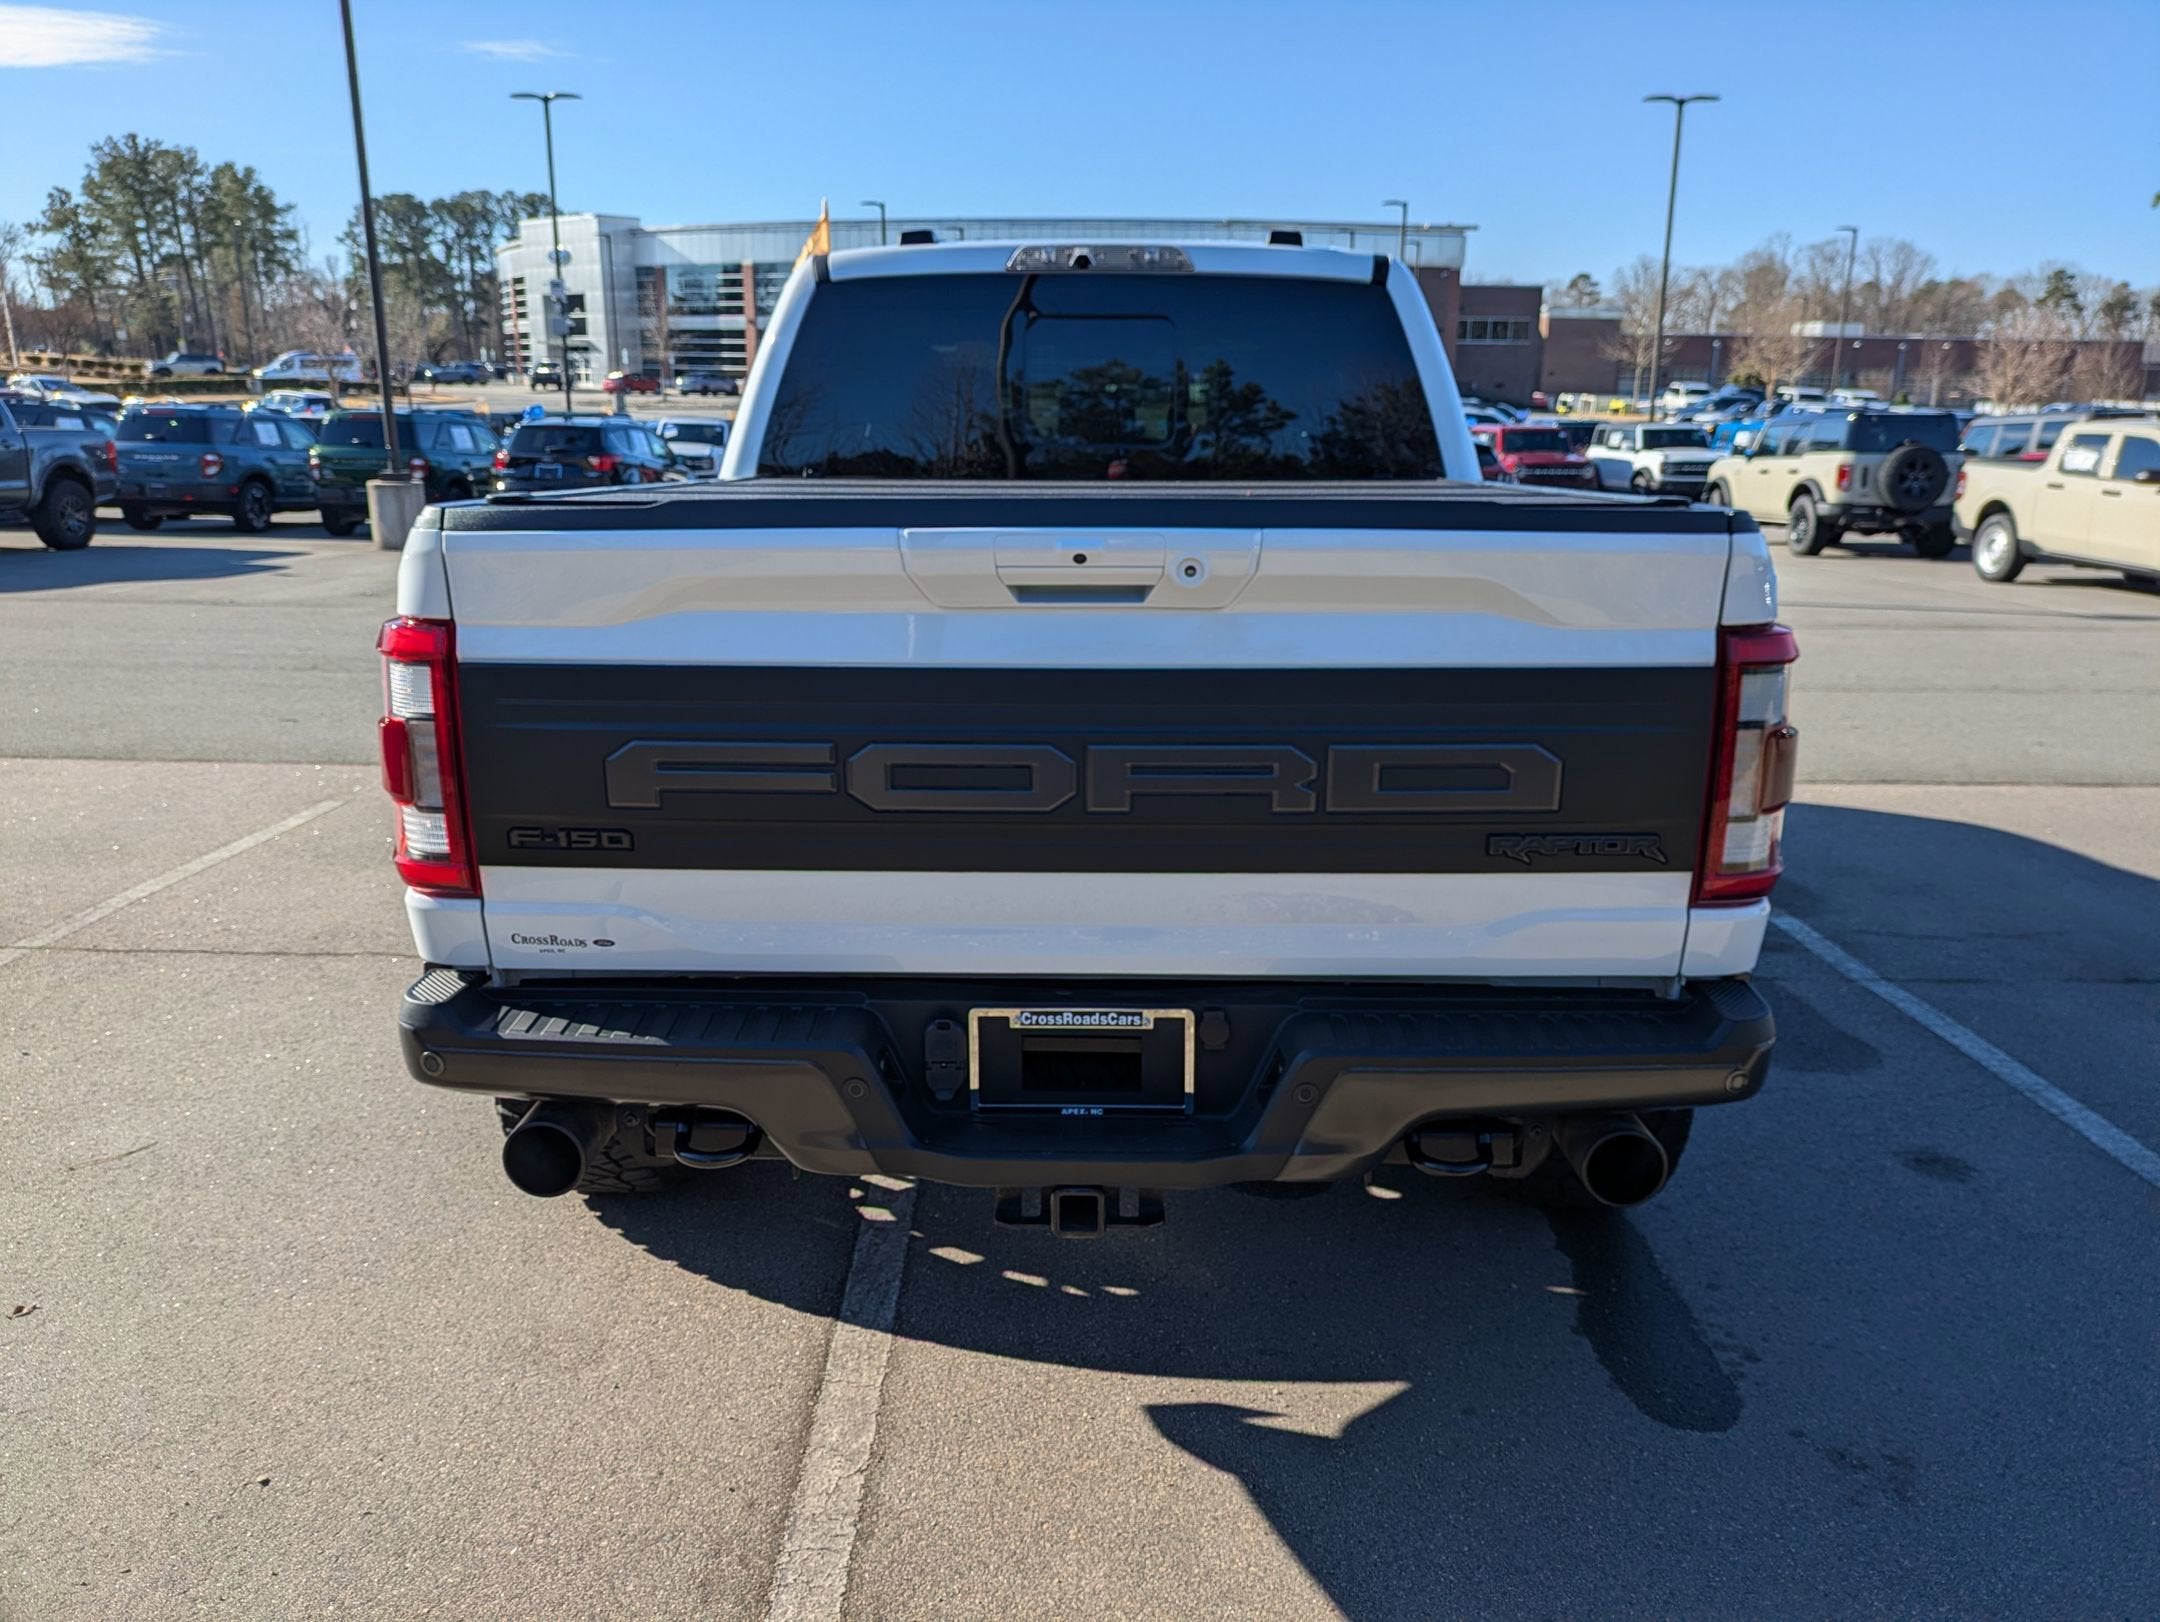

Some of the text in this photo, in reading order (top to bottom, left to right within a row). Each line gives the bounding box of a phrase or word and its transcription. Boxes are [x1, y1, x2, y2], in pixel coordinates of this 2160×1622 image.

[606, 741, 1562, 812] FORD
[507, 827, 634, 851] F-150
[1486, 833, 1668, 865] RAPTOR
[1021, 1012, 1141, 1026] CrossRoadsCars
